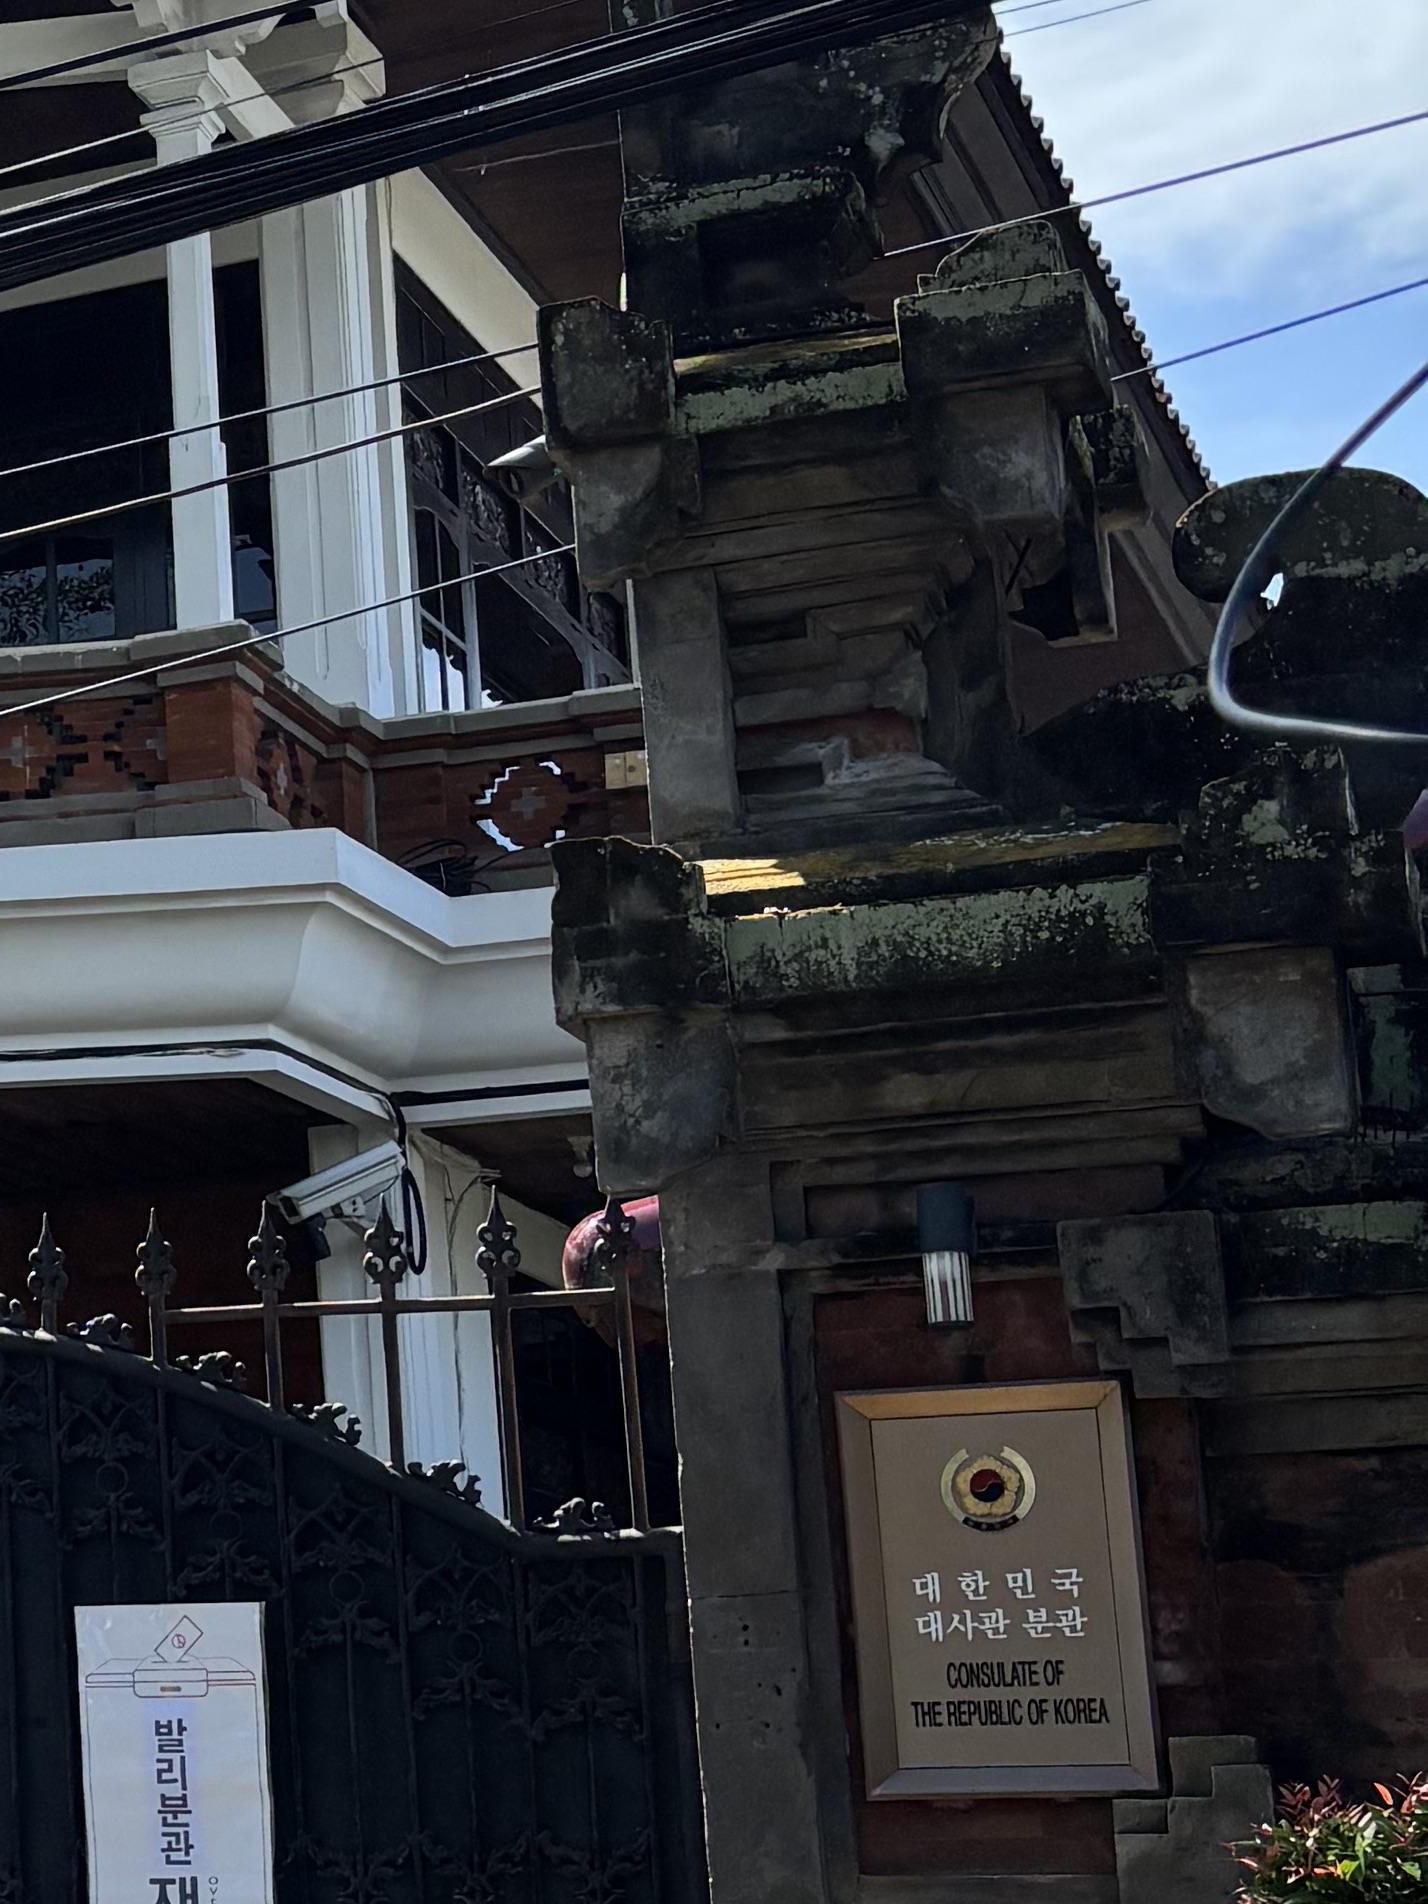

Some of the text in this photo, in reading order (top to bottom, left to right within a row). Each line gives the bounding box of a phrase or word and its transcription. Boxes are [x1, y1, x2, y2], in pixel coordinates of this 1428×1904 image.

[915, 1606, 1088, 1642] 대사관 분관
[947, 1660, 1065, 1689] CONSULATE OF
[911, 1698, 1110, 1728] THE REPUBLIC OF KOREA
[154, 1718, 194, 1866] 발리분관
